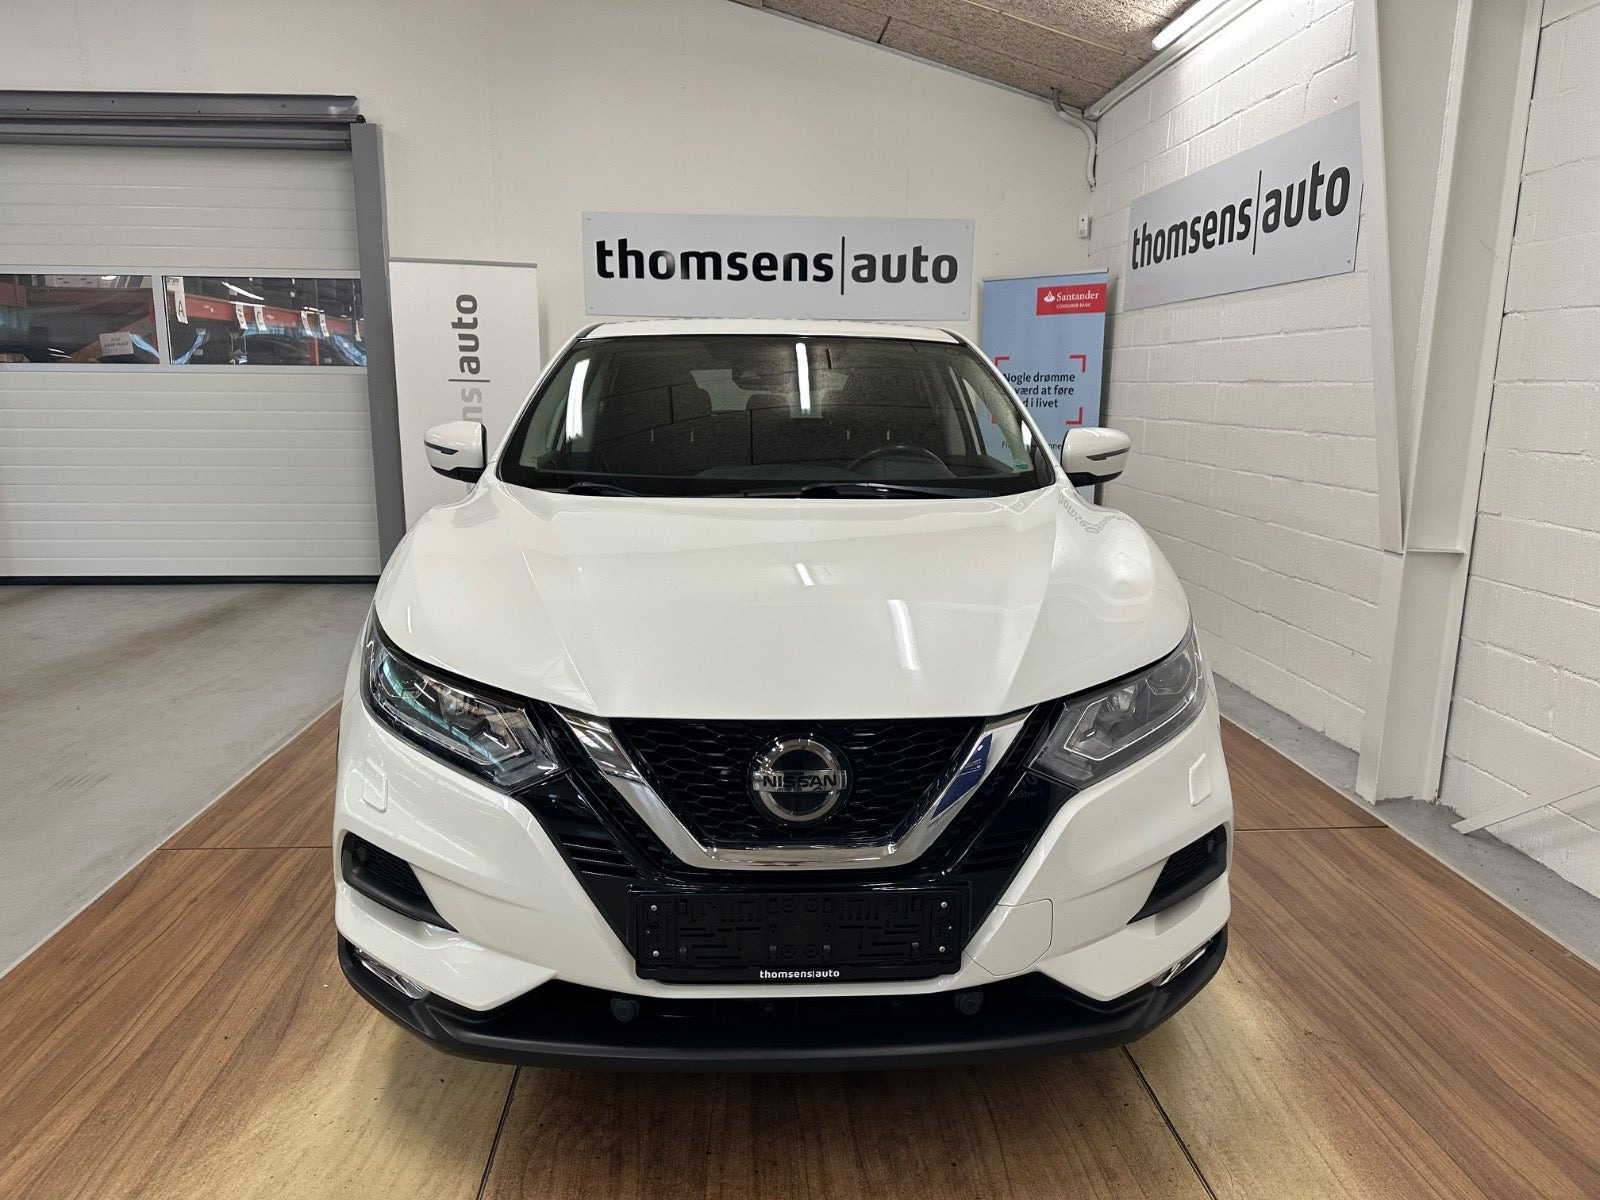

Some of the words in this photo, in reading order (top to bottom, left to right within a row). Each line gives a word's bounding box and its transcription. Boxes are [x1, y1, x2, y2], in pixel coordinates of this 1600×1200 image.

[1056, 290, 1099, 302] Santander
[1003, 372, 1032, 386] Nogle
[1033, 372, 1076, 382] drømme
[1015, 385, 1039, 395] værd
[1041, 387, 1052, 395] at
[1054, 385, 1075, 395] føre
[1036, 398, 1059, 408] livet
[762, 774, 837, 788] NISSAN
